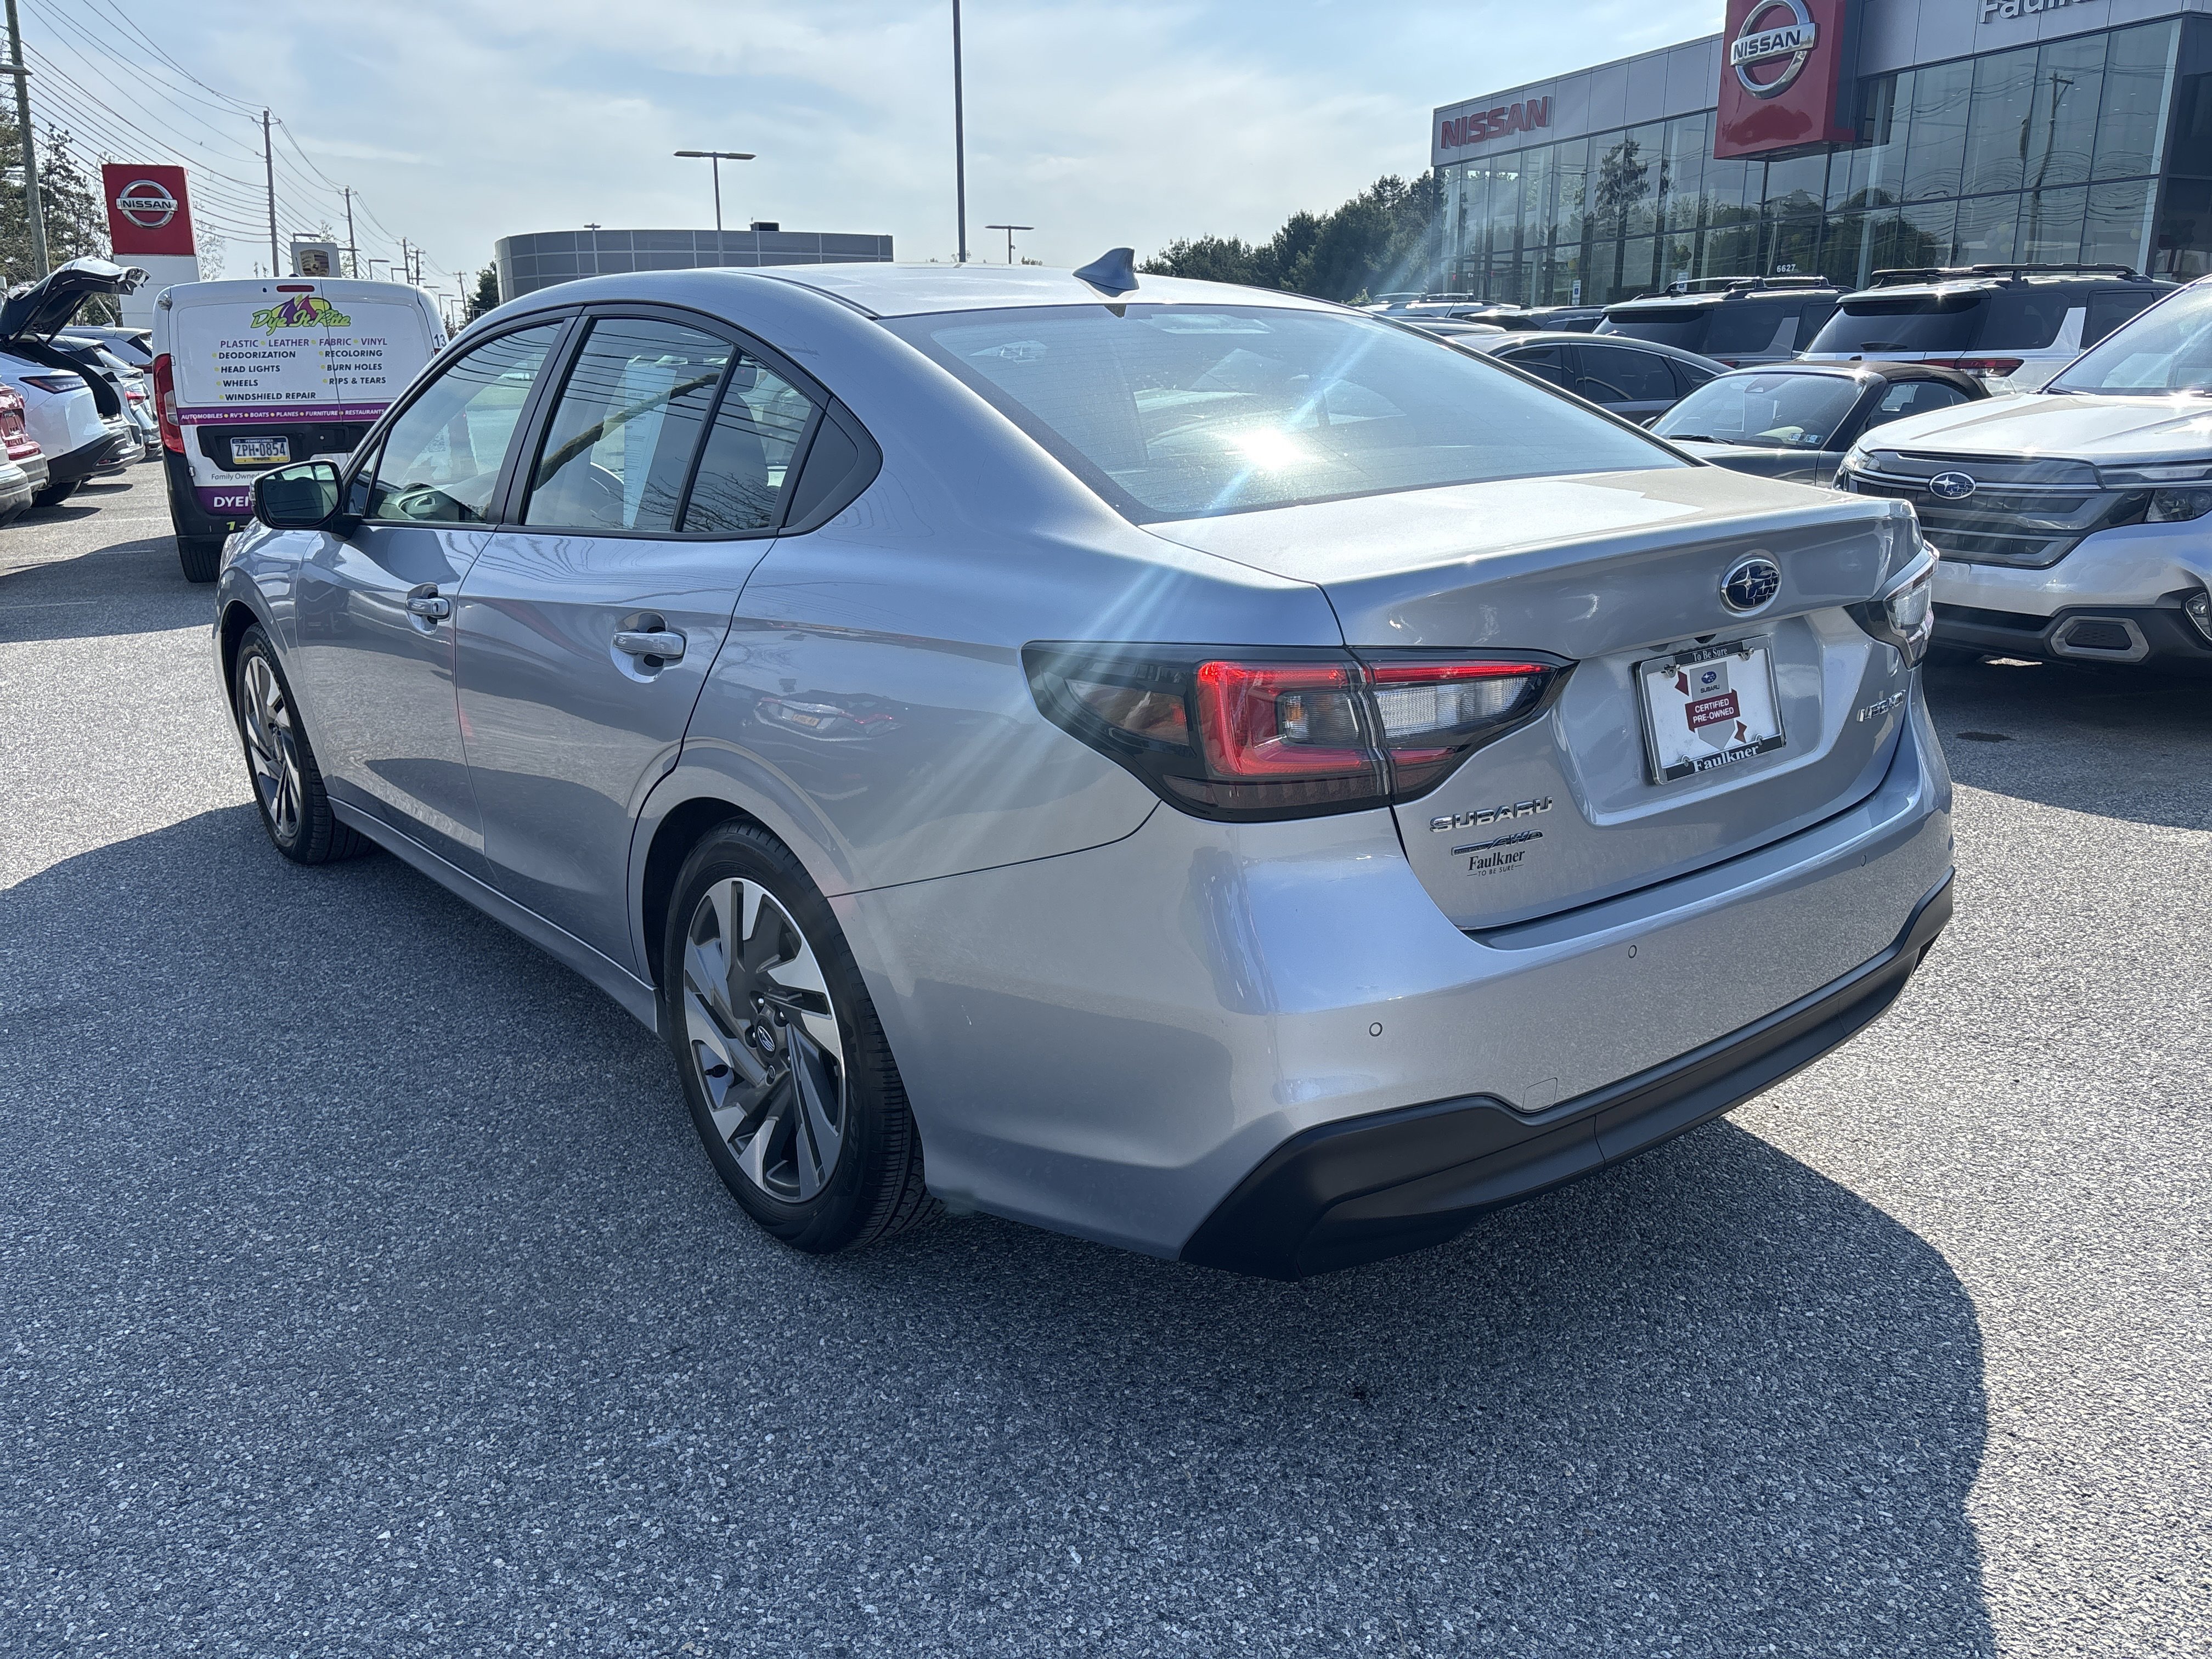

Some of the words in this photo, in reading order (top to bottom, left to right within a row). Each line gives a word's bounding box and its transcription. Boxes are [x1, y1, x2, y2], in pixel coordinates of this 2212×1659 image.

[1733, 29, 1801, 60] NISSAN
[1441, 95, 1553, 149] NISSAN
[122, 200, 171, 208] NISSAN
[1776, 263, 1796, 273] 6627
[250, 309, 288, 336] Dye
[289, 309, 311, 327] It
[310, 309, 352, 327] Rite
[220, 340, 259, 348] PLASTIC
[268, 338, 309, 347] LEATHER
[319, 338, 352, 346] FABRIC
[360, 337, 388, 346] VINYL
[434, 334, 447, 347] 13
[218, 351, 296, 359] DEODORIZATION
[223, 379, 258, 387] WHEELS
[225, 392, 283, 400] WINDSHIELD
[213, 496, 250, 507] DYEI
[1692, 651, 1702, 662] To
[1702, 650, 1712, 659] Be
[1712, 647, 1728, 657] Sure
[1700, 684, 1720, 693] SUBARU
[1695, 698, 1730, 713] CERTIFIED
[1692, 707, 1734, 724] PRE-OWNED
[1691, 744, 1759, 773] Faulkner
[1430, 795, 1553, 833] SUBARU
[1486, 829, 1543, 850] AWD
[1468, 850, 1525, 871] Faulkner
[1499, 864, 1515, 873] SURE
